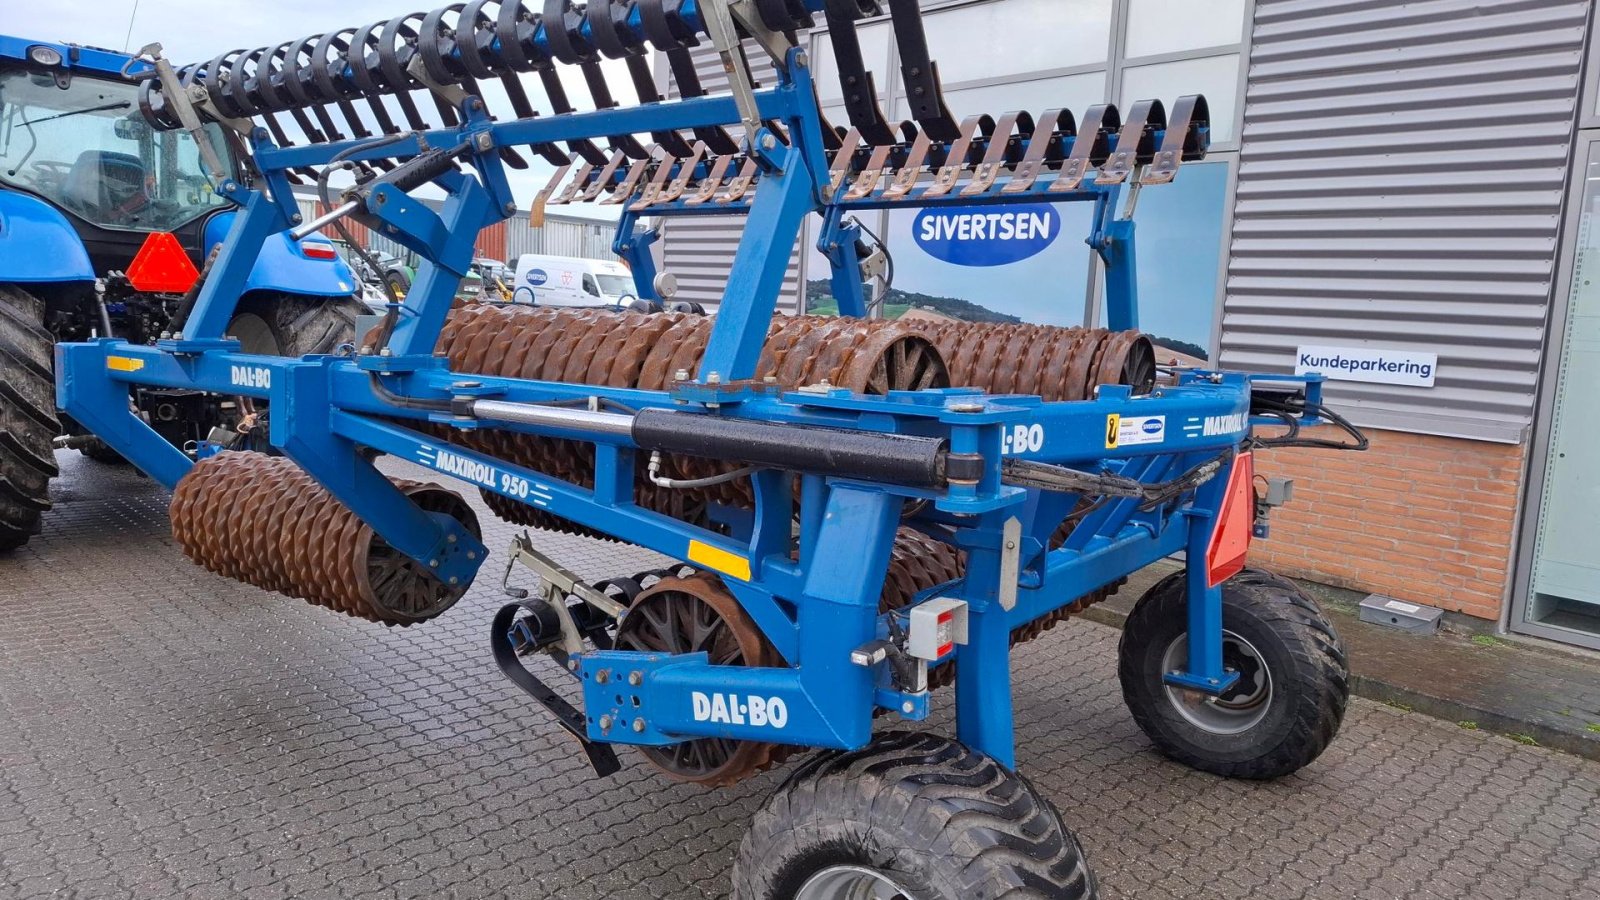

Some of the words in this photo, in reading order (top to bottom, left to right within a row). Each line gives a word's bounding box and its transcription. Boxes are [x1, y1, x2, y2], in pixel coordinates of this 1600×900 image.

[920, 212, 1050, 241] SIVERTSEN
[1300, 353, 1432, 379] Kundeparkering
[435, 450, 496, 488] MAXIROLL
[501, 473, 529, 499] 950
